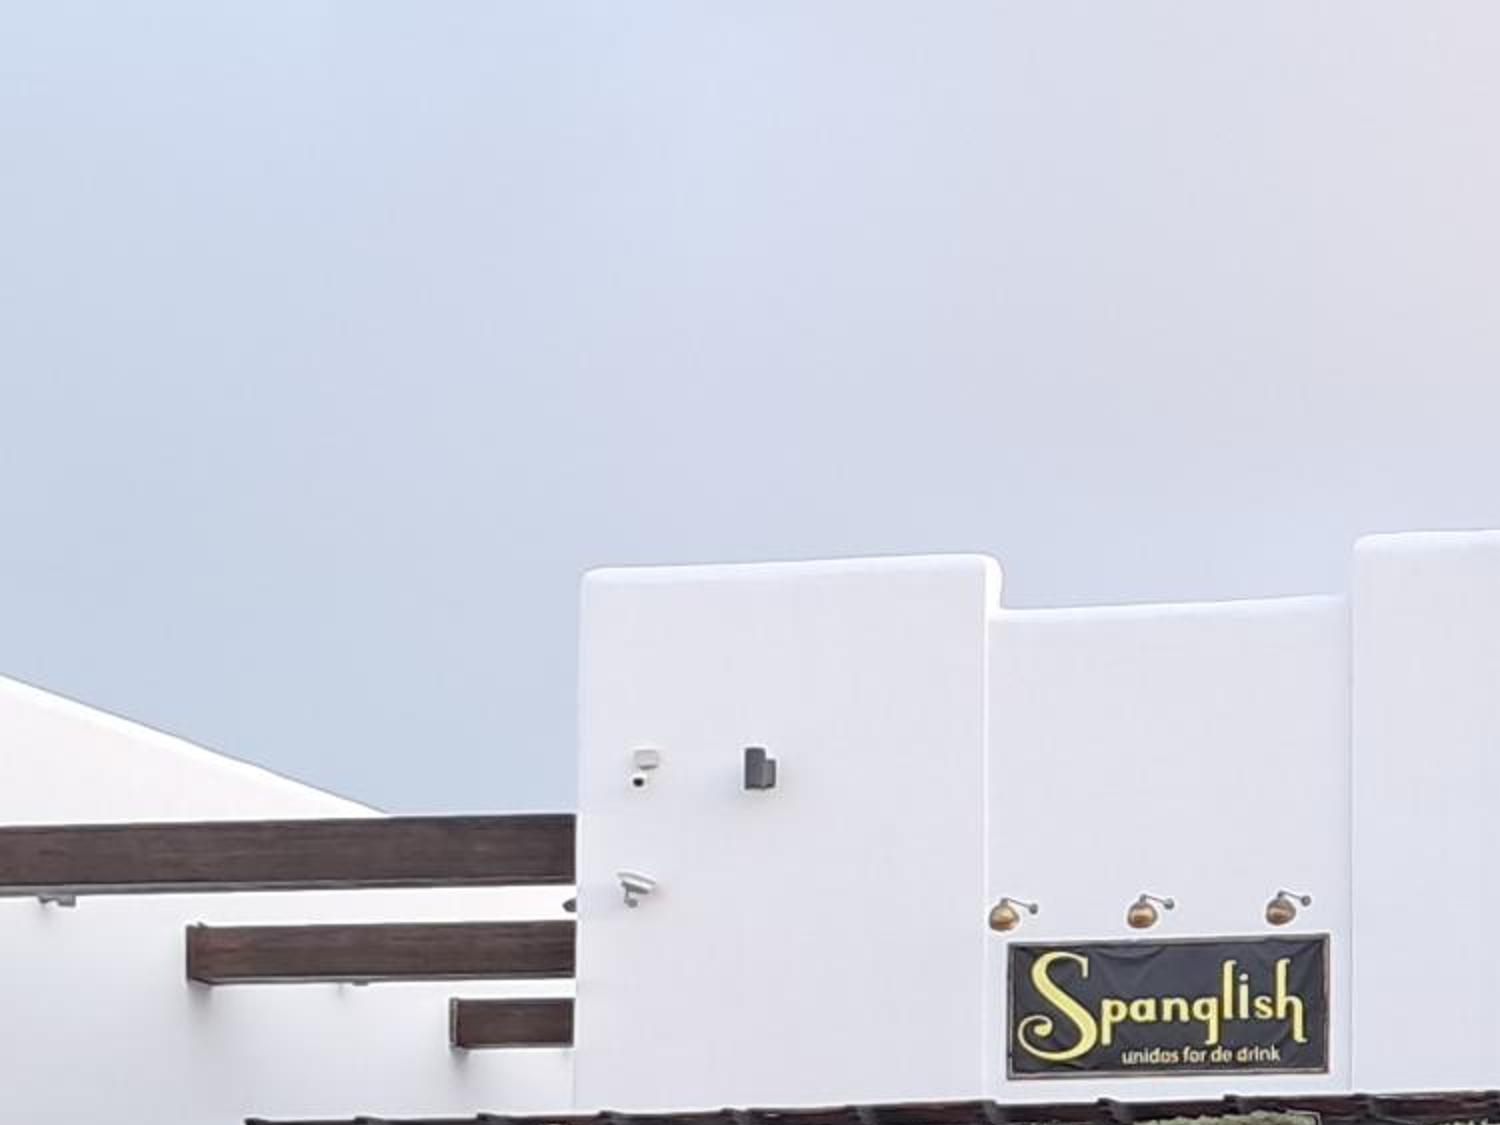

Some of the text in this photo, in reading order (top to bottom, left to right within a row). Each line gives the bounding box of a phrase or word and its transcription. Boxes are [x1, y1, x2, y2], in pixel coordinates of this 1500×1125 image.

[1017, 951, 1307, 1061] Spanglish
[1121, 1043, 1281, 1065] unidos for de drink
